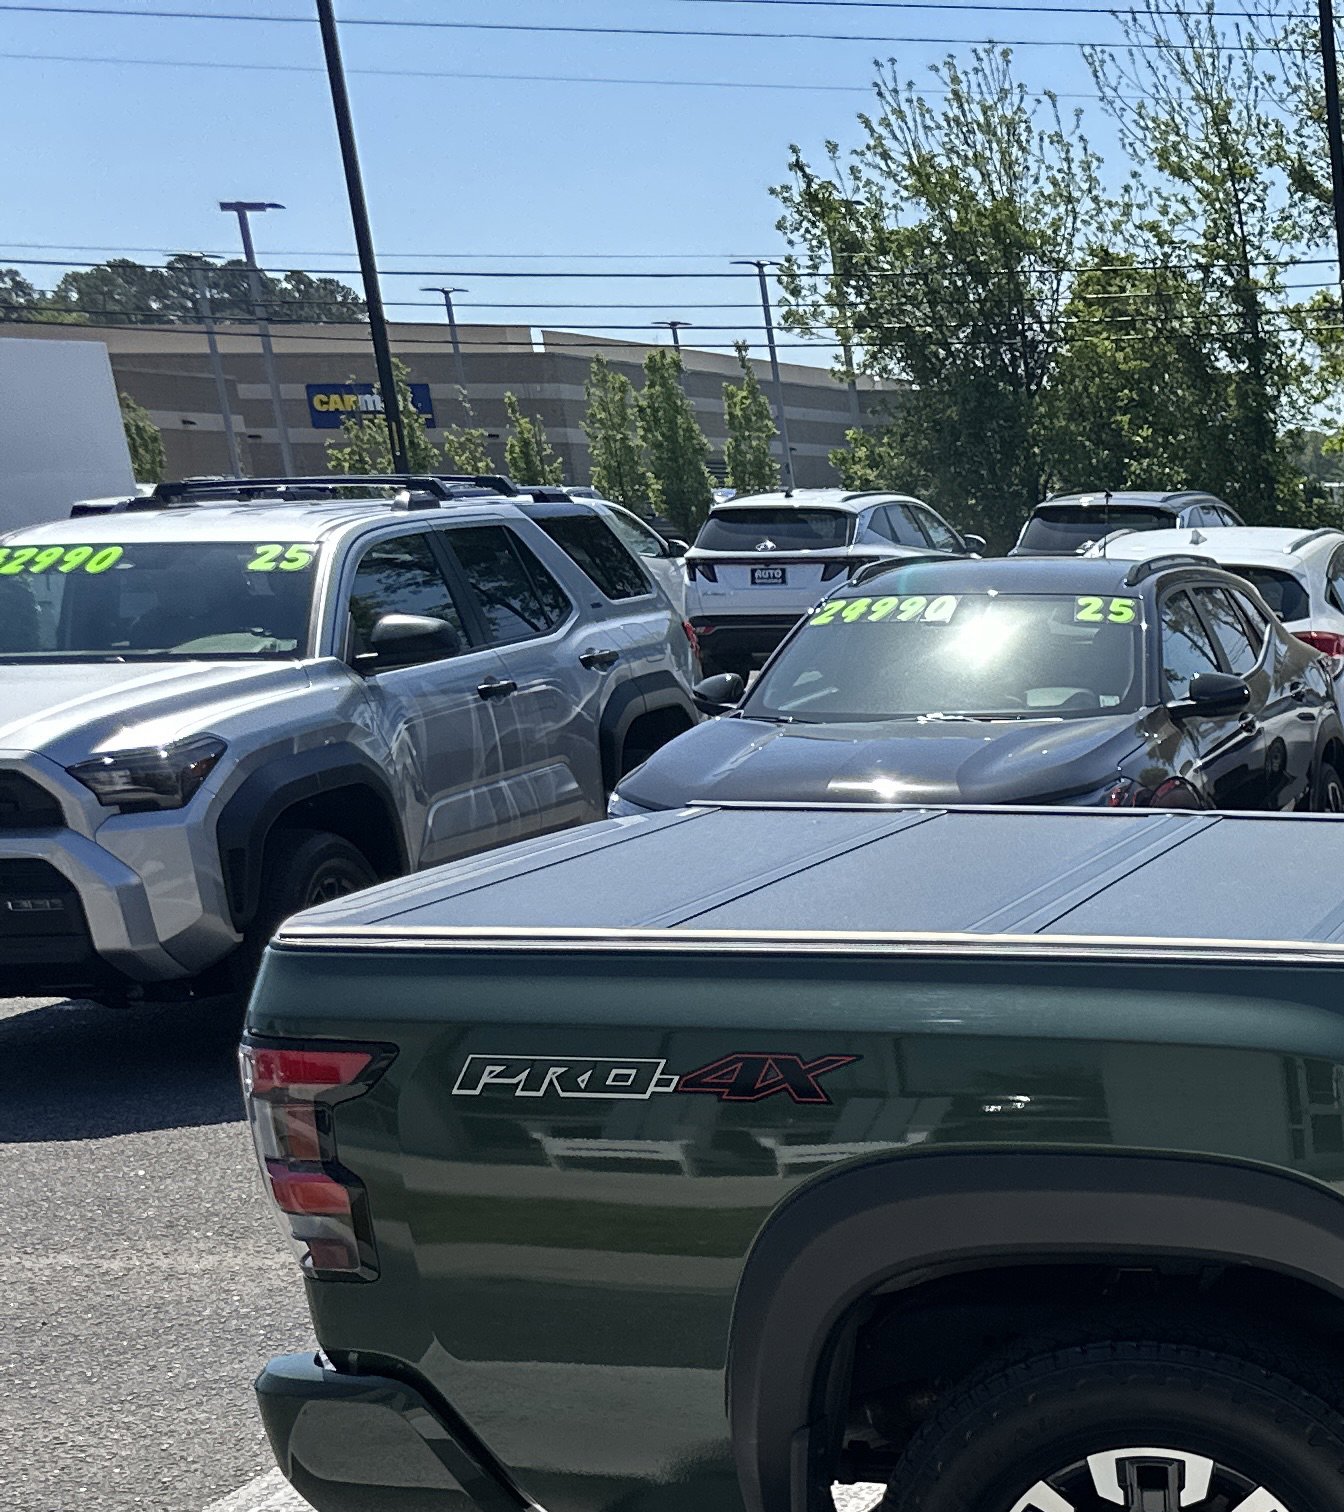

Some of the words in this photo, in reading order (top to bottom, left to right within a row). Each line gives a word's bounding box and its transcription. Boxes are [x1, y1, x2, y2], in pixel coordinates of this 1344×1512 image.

[0, 546, 124, 575] 2990
[247, 543, 319, 572] 25
[755, 569, 782, 579] AUTO
[810, 594, 958, 626] 24990
[1075, 596, 1136, 624] 25
[451, 1053, 867, 1104] PRO-4X
